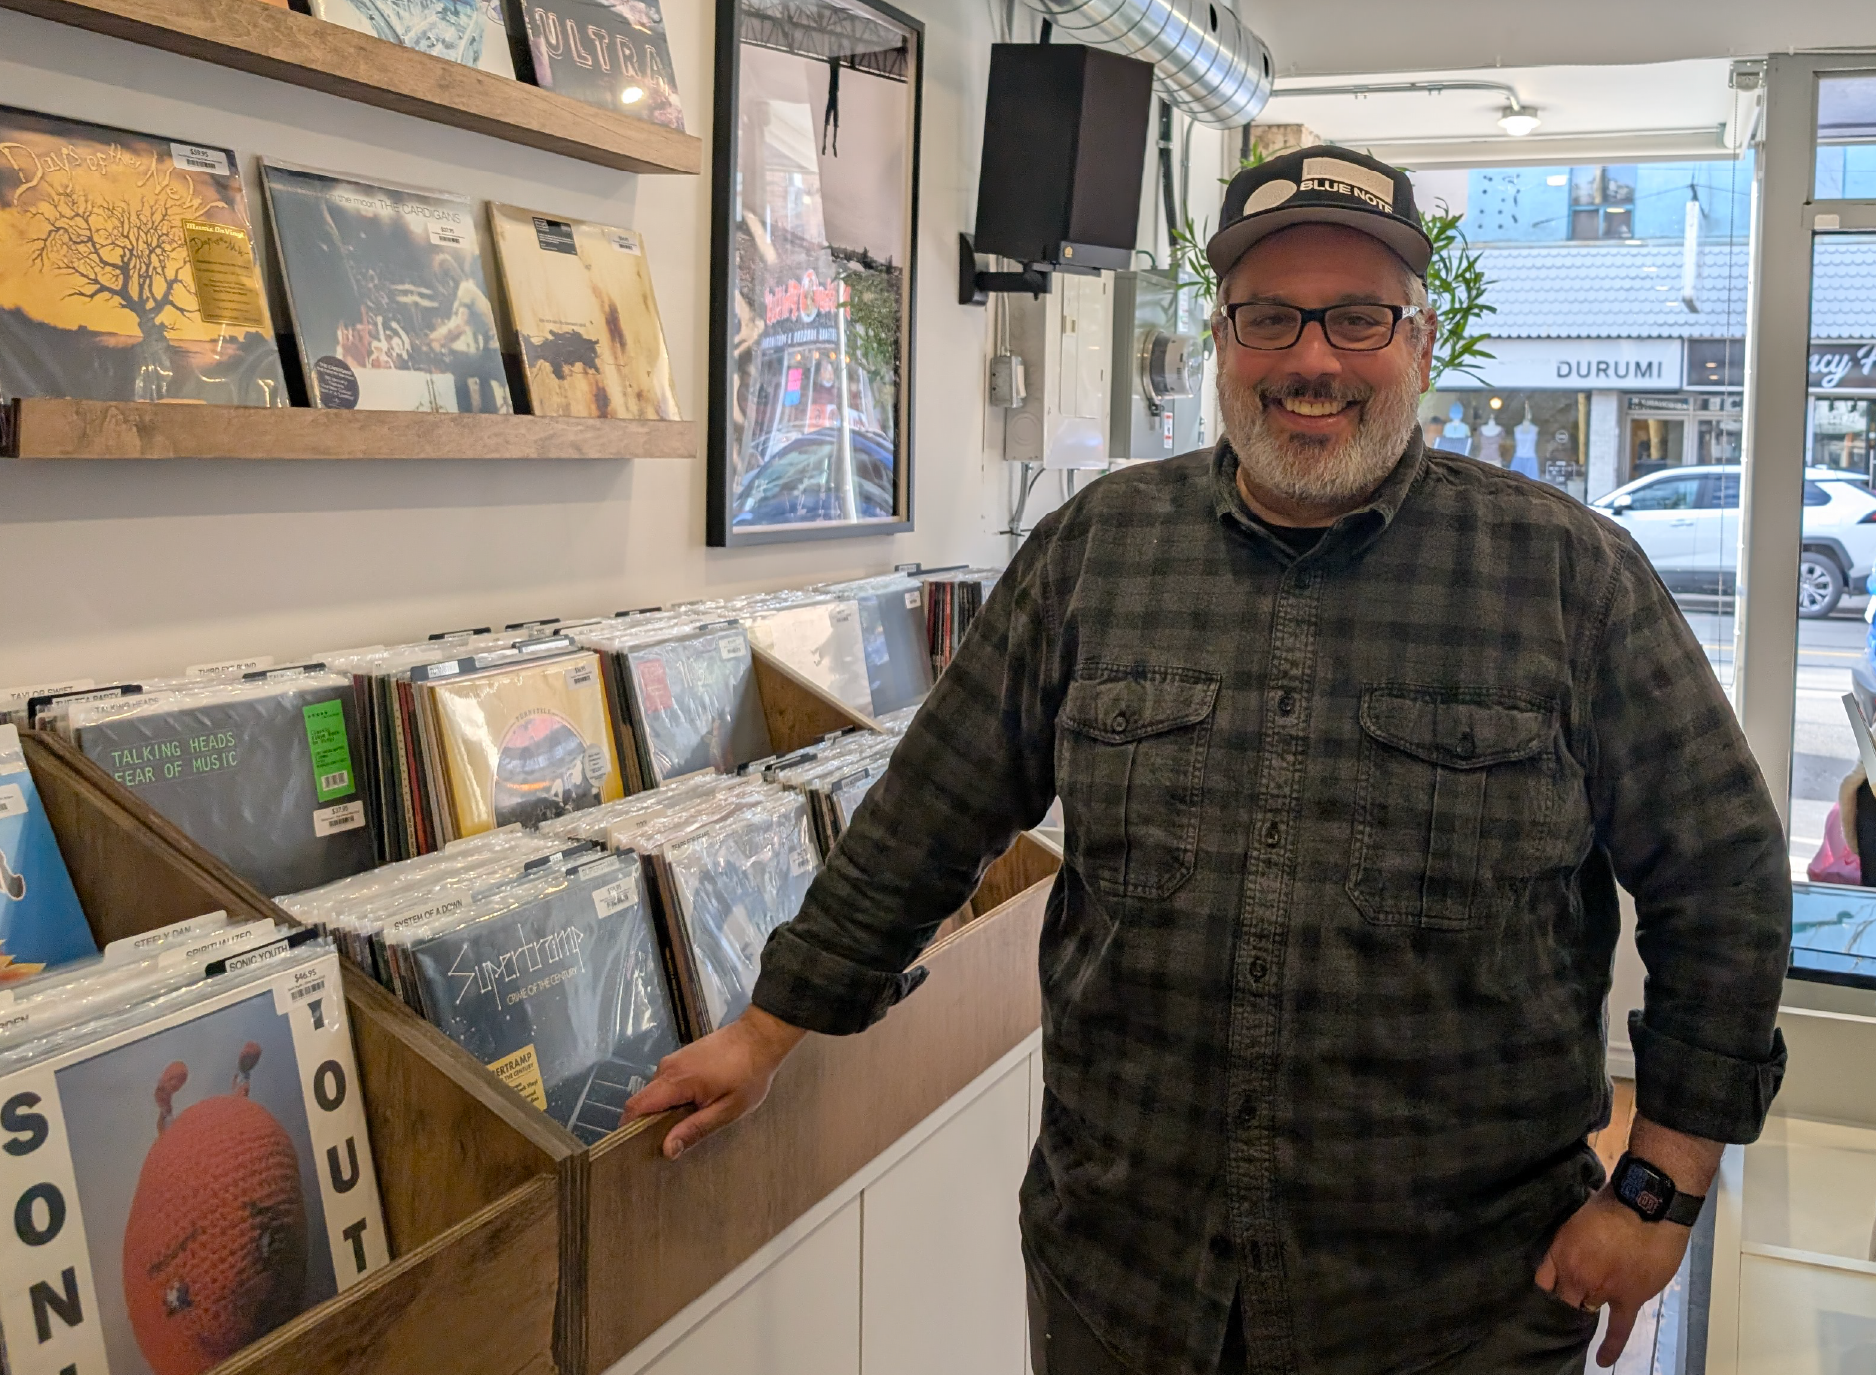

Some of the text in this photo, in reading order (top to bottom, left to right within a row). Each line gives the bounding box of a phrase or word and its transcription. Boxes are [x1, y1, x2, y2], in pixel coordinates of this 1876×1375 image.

[534, 8, 668, 96] ULTRA
[0, 142, 81, 206] Days
[87, 153, 108, 175] of
[337, 194, 351, 204] the
[353, 196, 377, 209] moon
[378, 200, 400, 213] THE
[402, 203, 462, 224] CARDIGANS
[1300, 180, 1394, 214] BLUE NOTE
[1556, 361, 1663, 379] DURUMI
[112, 732, 236, 767] TALKING HEADS
[115, 751, 238, 786] FEAR OF MUSIC
[394, 913, 423, 931] SYSTEM
[424, 909, 434, 919] OF
[441, 899, 463, 914] DOWN
[229, 944, 288, 972] SONIC YOUTH
[294, 968, 317, 983] $46.95
[507, 988, 528, 1005] CRIME
[528, 983, 538, 996] OF
[551, 966, 577, 985] CENTURY
[0, 1091, 84, 1375] SON
